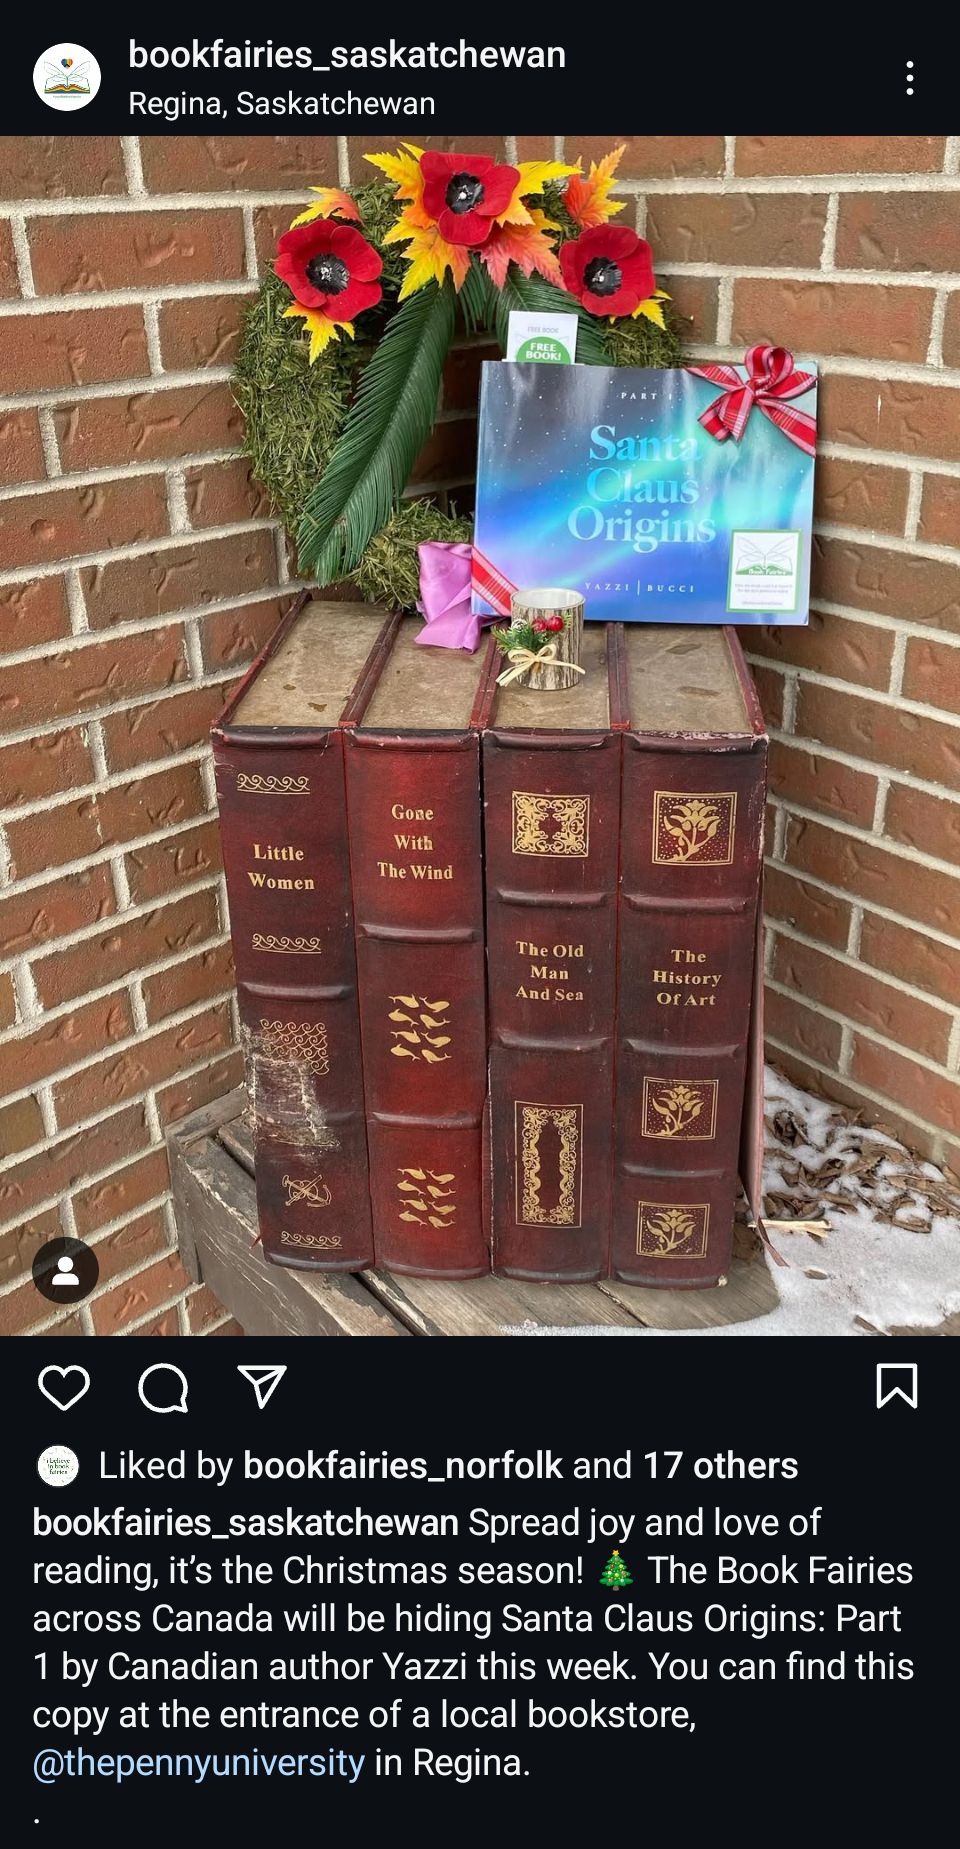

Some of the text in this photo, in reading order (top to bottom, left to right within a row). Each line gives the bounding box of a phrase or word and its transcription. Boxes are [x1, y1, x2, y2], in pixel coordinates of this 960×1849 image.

[525, 350, 562, 361] BOOK!
[530, 342, 557, 352] FREE
[621, 392, 657, 400] PART
[589, 424, 701, 462] Santa
[586, 466, 699, 504] Claus
[567, 505, 717, 554] Origins
[585, 582, 694, 593] YAZZI BUCCI
[391, 803, 434, 821] Gone
[394, 834, 434, 851] With
[253, 843, 305, 861] Little
[377, 862, 454, 880] The Wind
[247, 871, 315, 890] Women
[516, 940, 585, 958] The Old
[671, 949, 707, 963] The
[530, 965, 569, 980] Man
[652, 969, 722, 987] History
[515, 986, 584, 1001] And Sea
[656, 992, 716, 1006] Of Art
